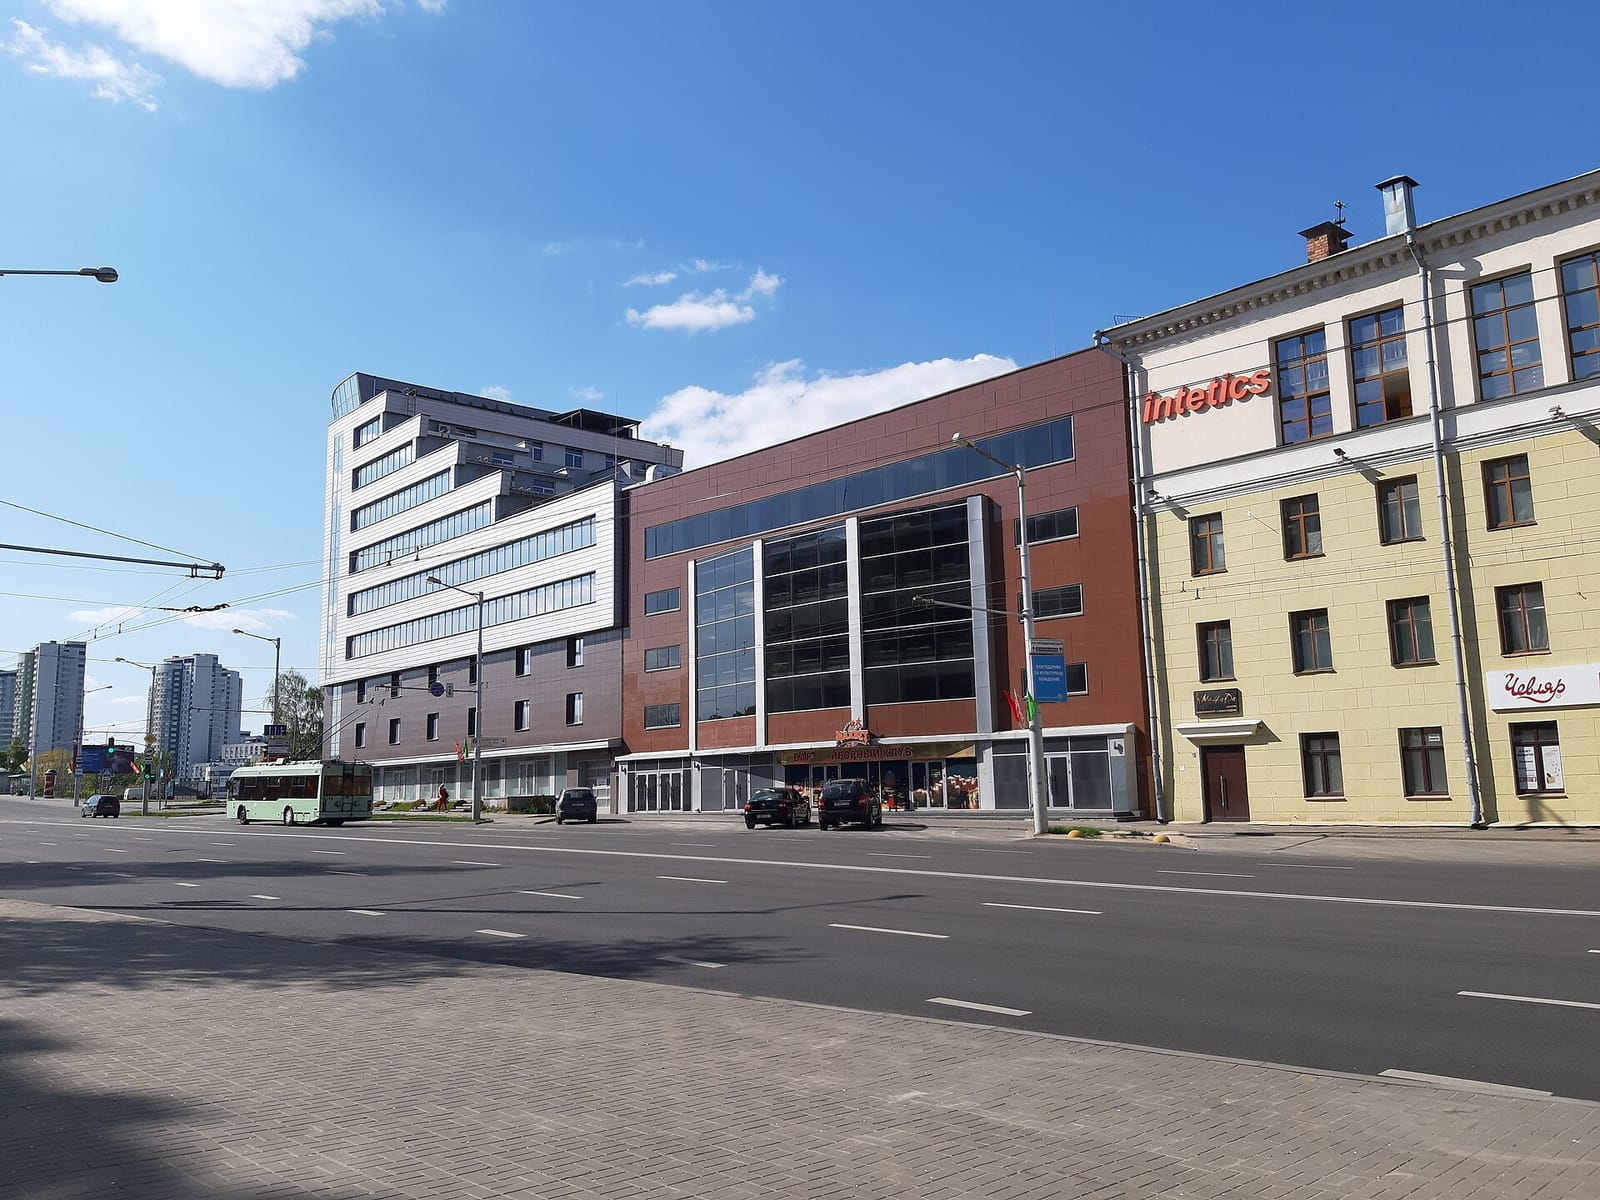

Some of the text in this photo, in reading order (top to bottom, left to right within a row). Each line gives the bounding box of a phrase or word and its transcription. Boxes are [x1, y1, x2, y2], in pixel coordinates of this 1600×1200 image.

[1143, 370, 1271, 423] intetics
[1505, 673, 1566, 703] Чевляр
[882, 747, 913, 758] КЛУБ
